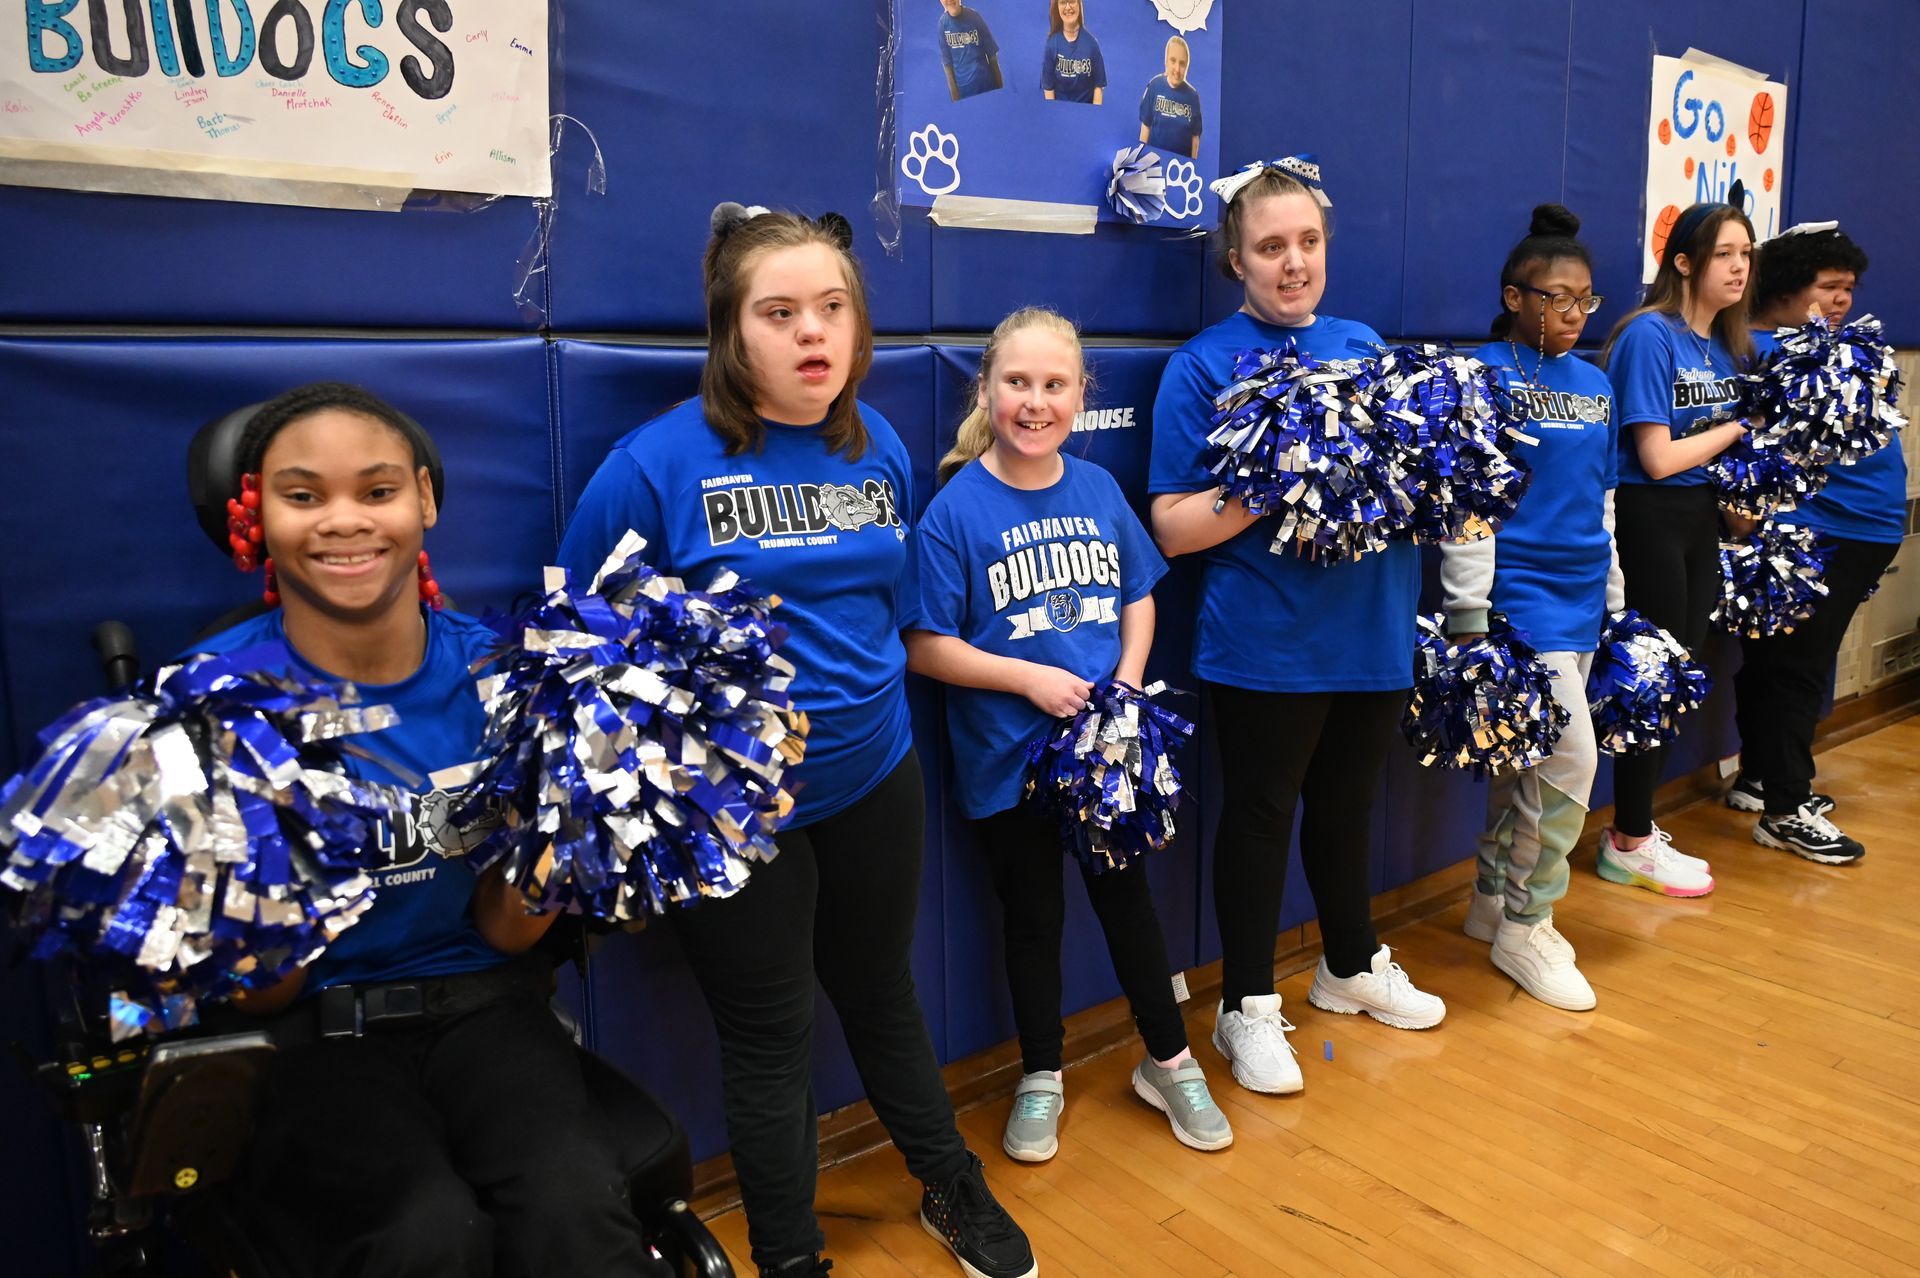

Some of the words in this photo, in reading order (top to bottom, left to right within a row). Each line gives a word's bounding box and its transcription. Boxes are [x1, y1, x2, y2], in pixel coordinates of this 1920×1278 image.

[509, 37, 533, 57] Emma
[174, 86, 208, 101] Lindsey
[272, 88, 306, 97] Danielle
[1673, 70, 1725, 143] Go
[74, 111, 109, 137] Angela
[197, 112, 224, 129] Barb
[434, 151, 454, 165] Erin
[1673, 377, 1741, 410] BULLDO
[1510, 388, 1612, 426] BULLDG
[701, 474, 753, 489] FAIRHAVEN
[758, 537, 805, 549] TRUMBULL
[806, 535, 838, 546] COUNTY
[1001, 517, 1100, 551] FAIRHAVEN
[987, 540, 1121, 613] BULLDOGS
[384, 867, 437, 886] COUNTY
